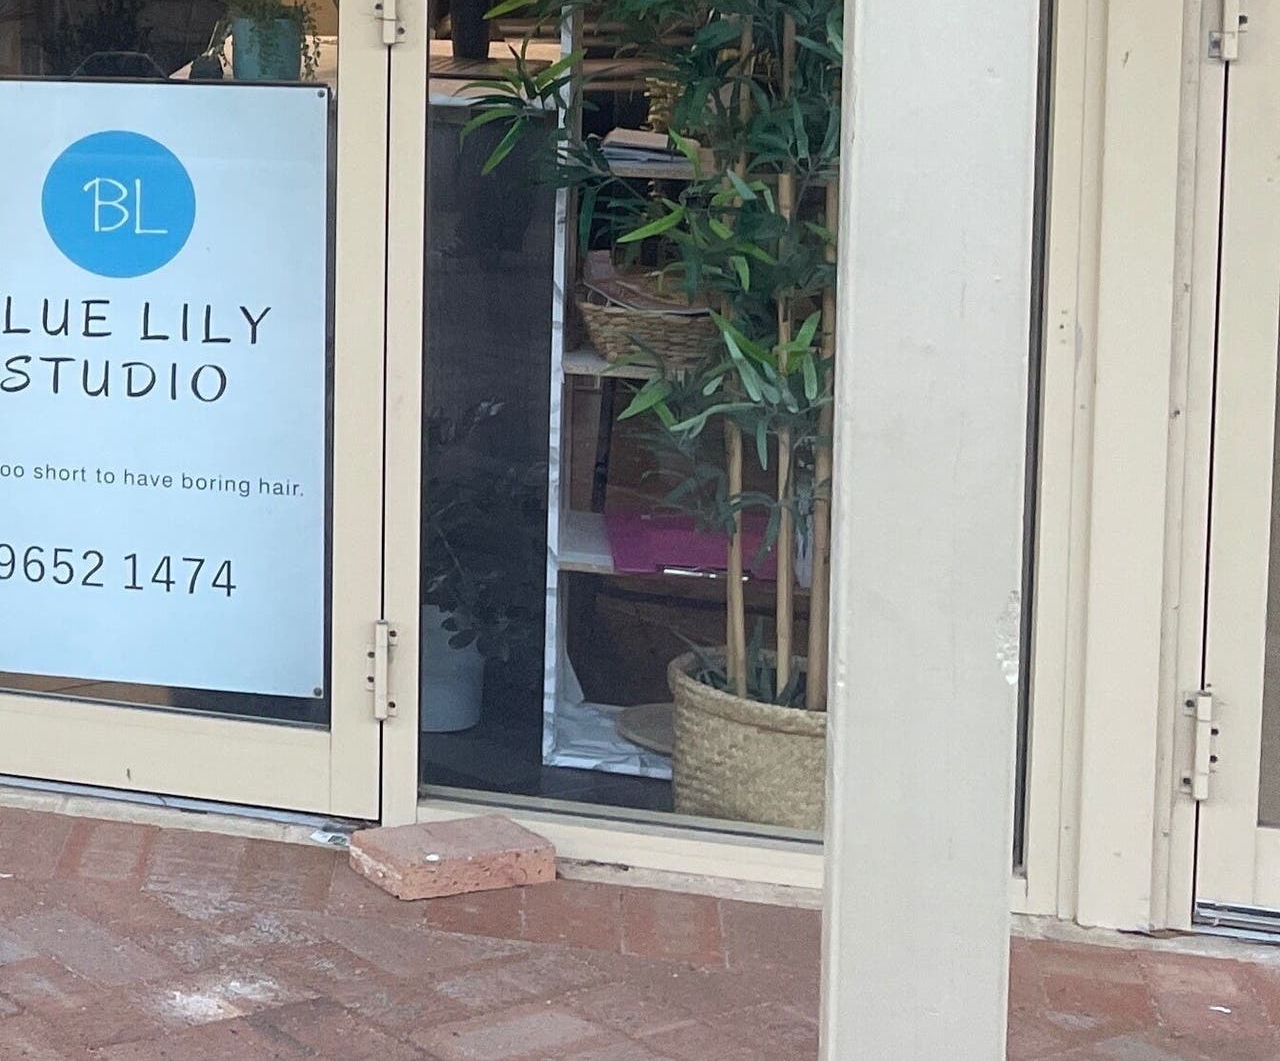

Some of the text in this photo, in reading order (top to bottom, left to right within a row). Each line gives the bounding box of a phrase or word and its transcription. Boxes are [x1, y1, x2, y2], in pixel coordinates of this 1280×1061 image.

[83, 176, 169, 234] BL
[139, 300, 273, 345] LILY
[0, 354, 228, 403] STUDIO
[33, 463, 87, 483] short
[96, 467, 116, 485] to
[123, 470, 174, 489] have
[181, 473, 251, 498] boring
[258, 477, 305, 497] hair.
[123, 552, 237, 598] 1474
